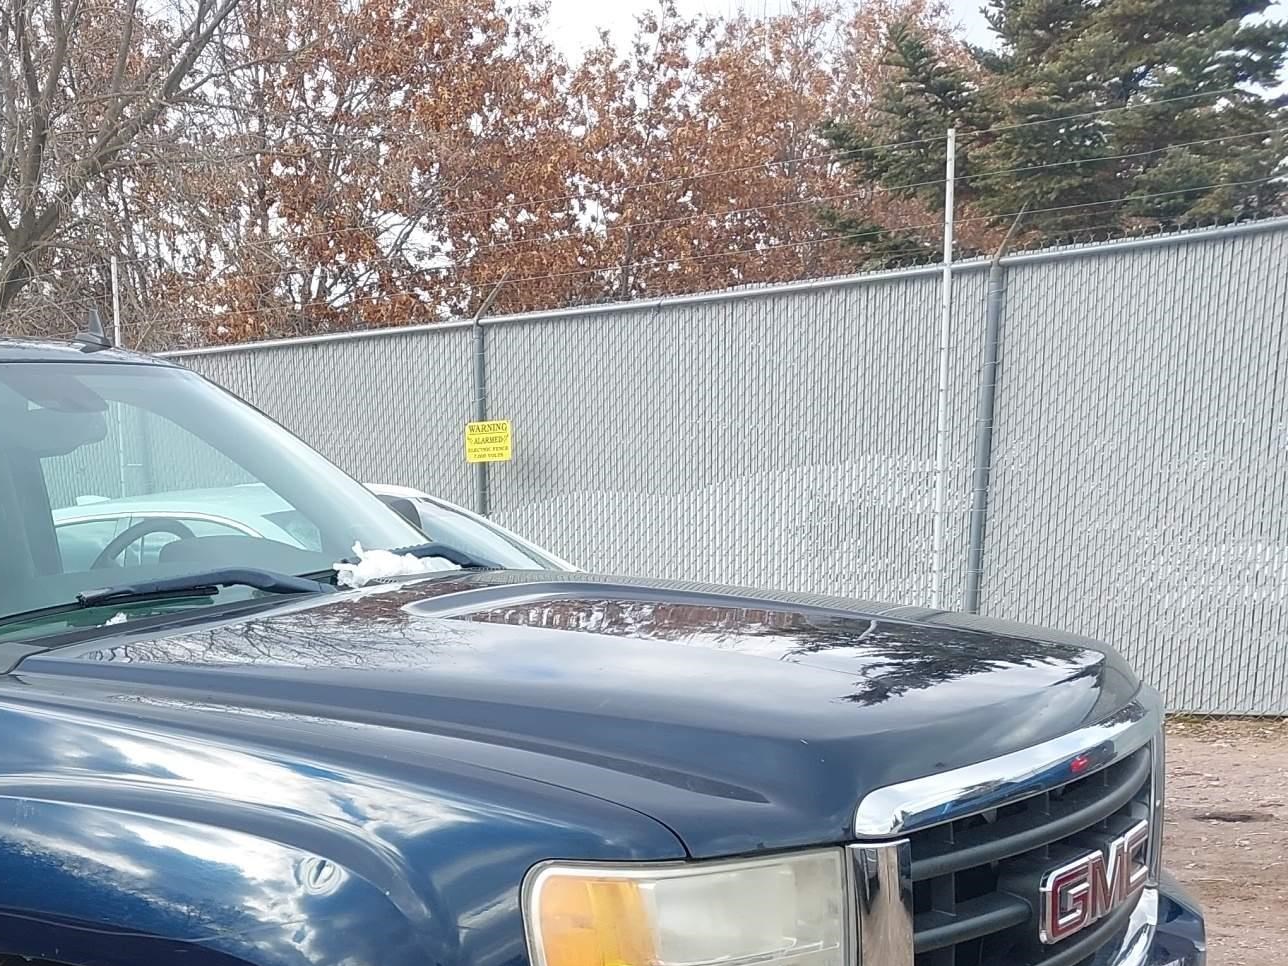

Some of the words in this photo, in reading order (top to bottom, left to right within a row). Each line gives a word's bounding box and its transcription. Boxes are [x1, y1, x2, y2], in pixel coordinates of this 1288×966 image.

[469, 423, 508, 433] WARNING
[473, 436, 504, 444] ALARMED
[1039, 819, 1149, 945] GMC
